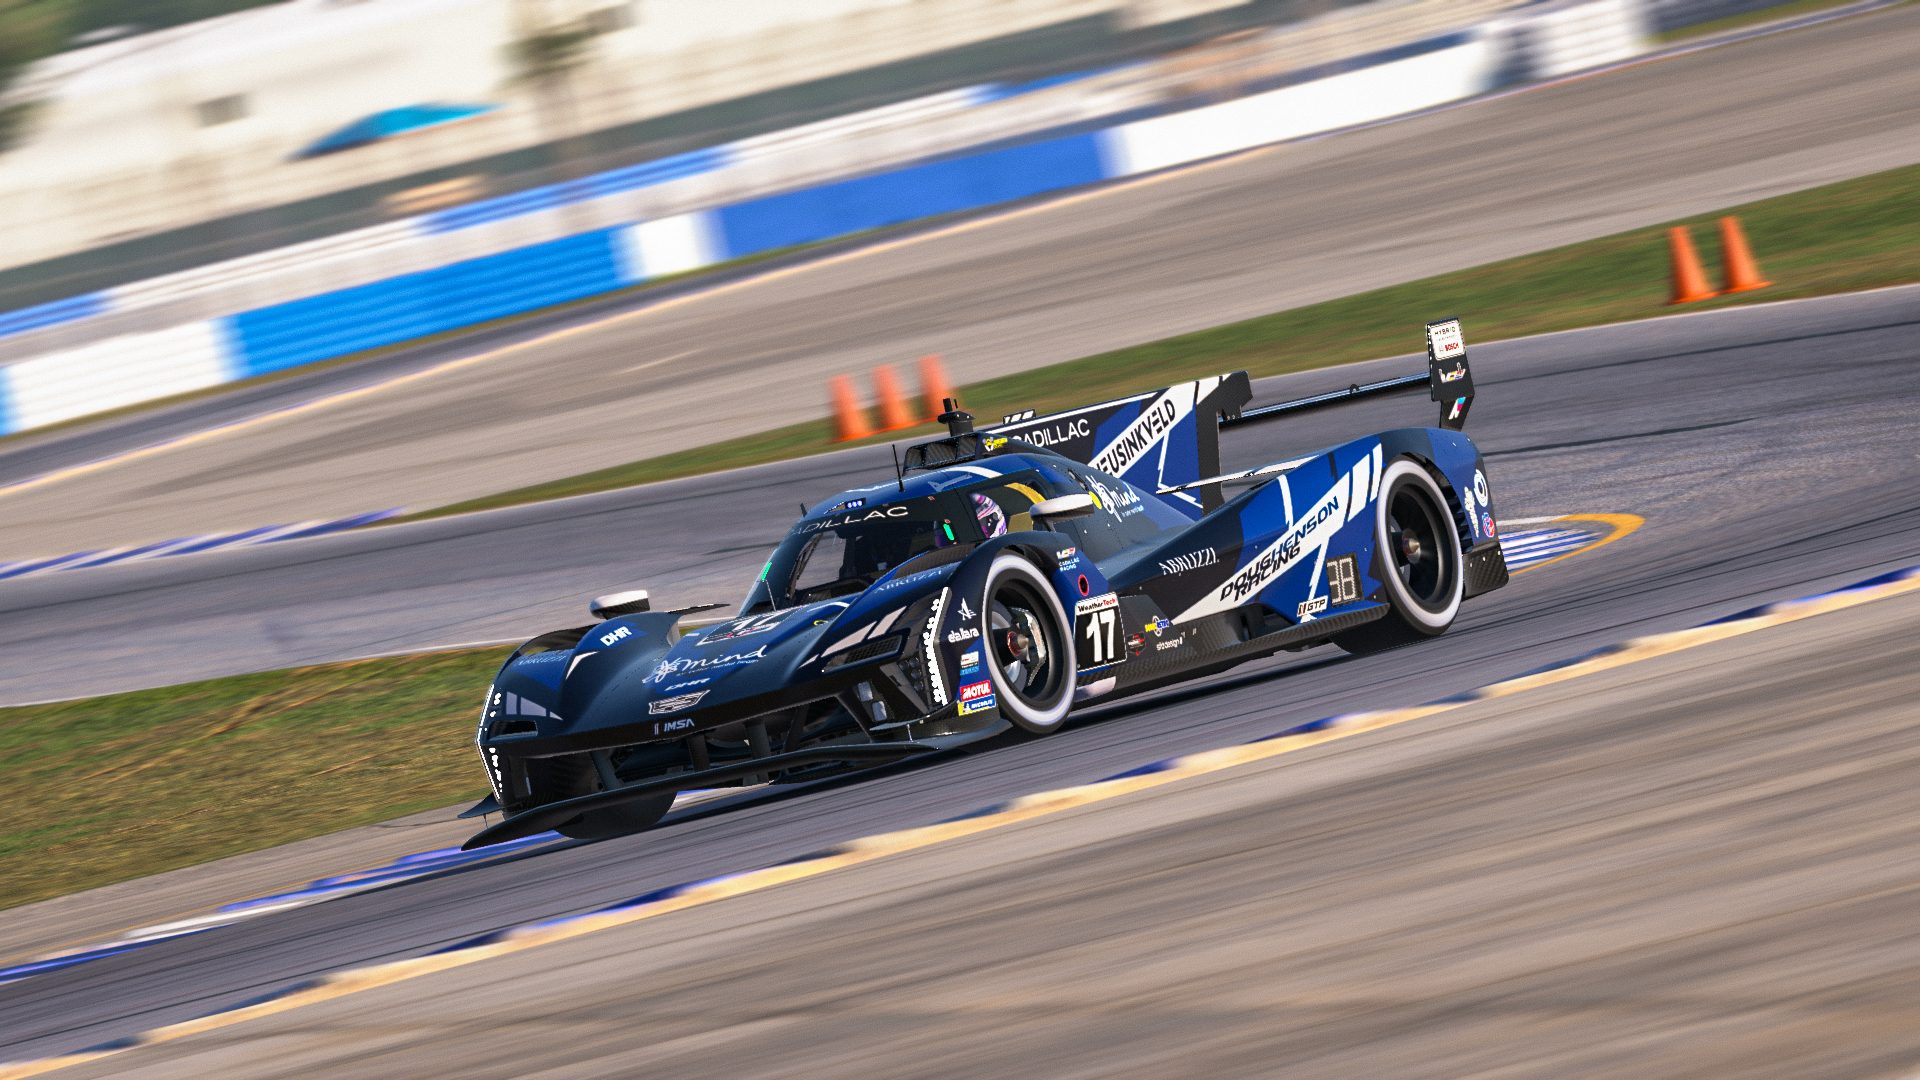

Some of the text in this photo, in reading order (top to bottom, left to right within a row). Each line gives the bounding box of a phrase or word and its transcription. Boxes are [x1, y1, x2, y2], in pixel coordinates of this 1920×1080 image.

[1013, 418, 1091, 448] ADILLAC
[1233, 545, 1301, 602] RACING
[1078, 597, 1117, 613] WeatherTech
[1307, 599, 1326, 612] GTP
[600, 626, 633, 647] DHR
[1086, 608, 1116, 662] 17
[962, 682, 991, 699] MOTUL
[664, 718, 695, 732] IMSA
